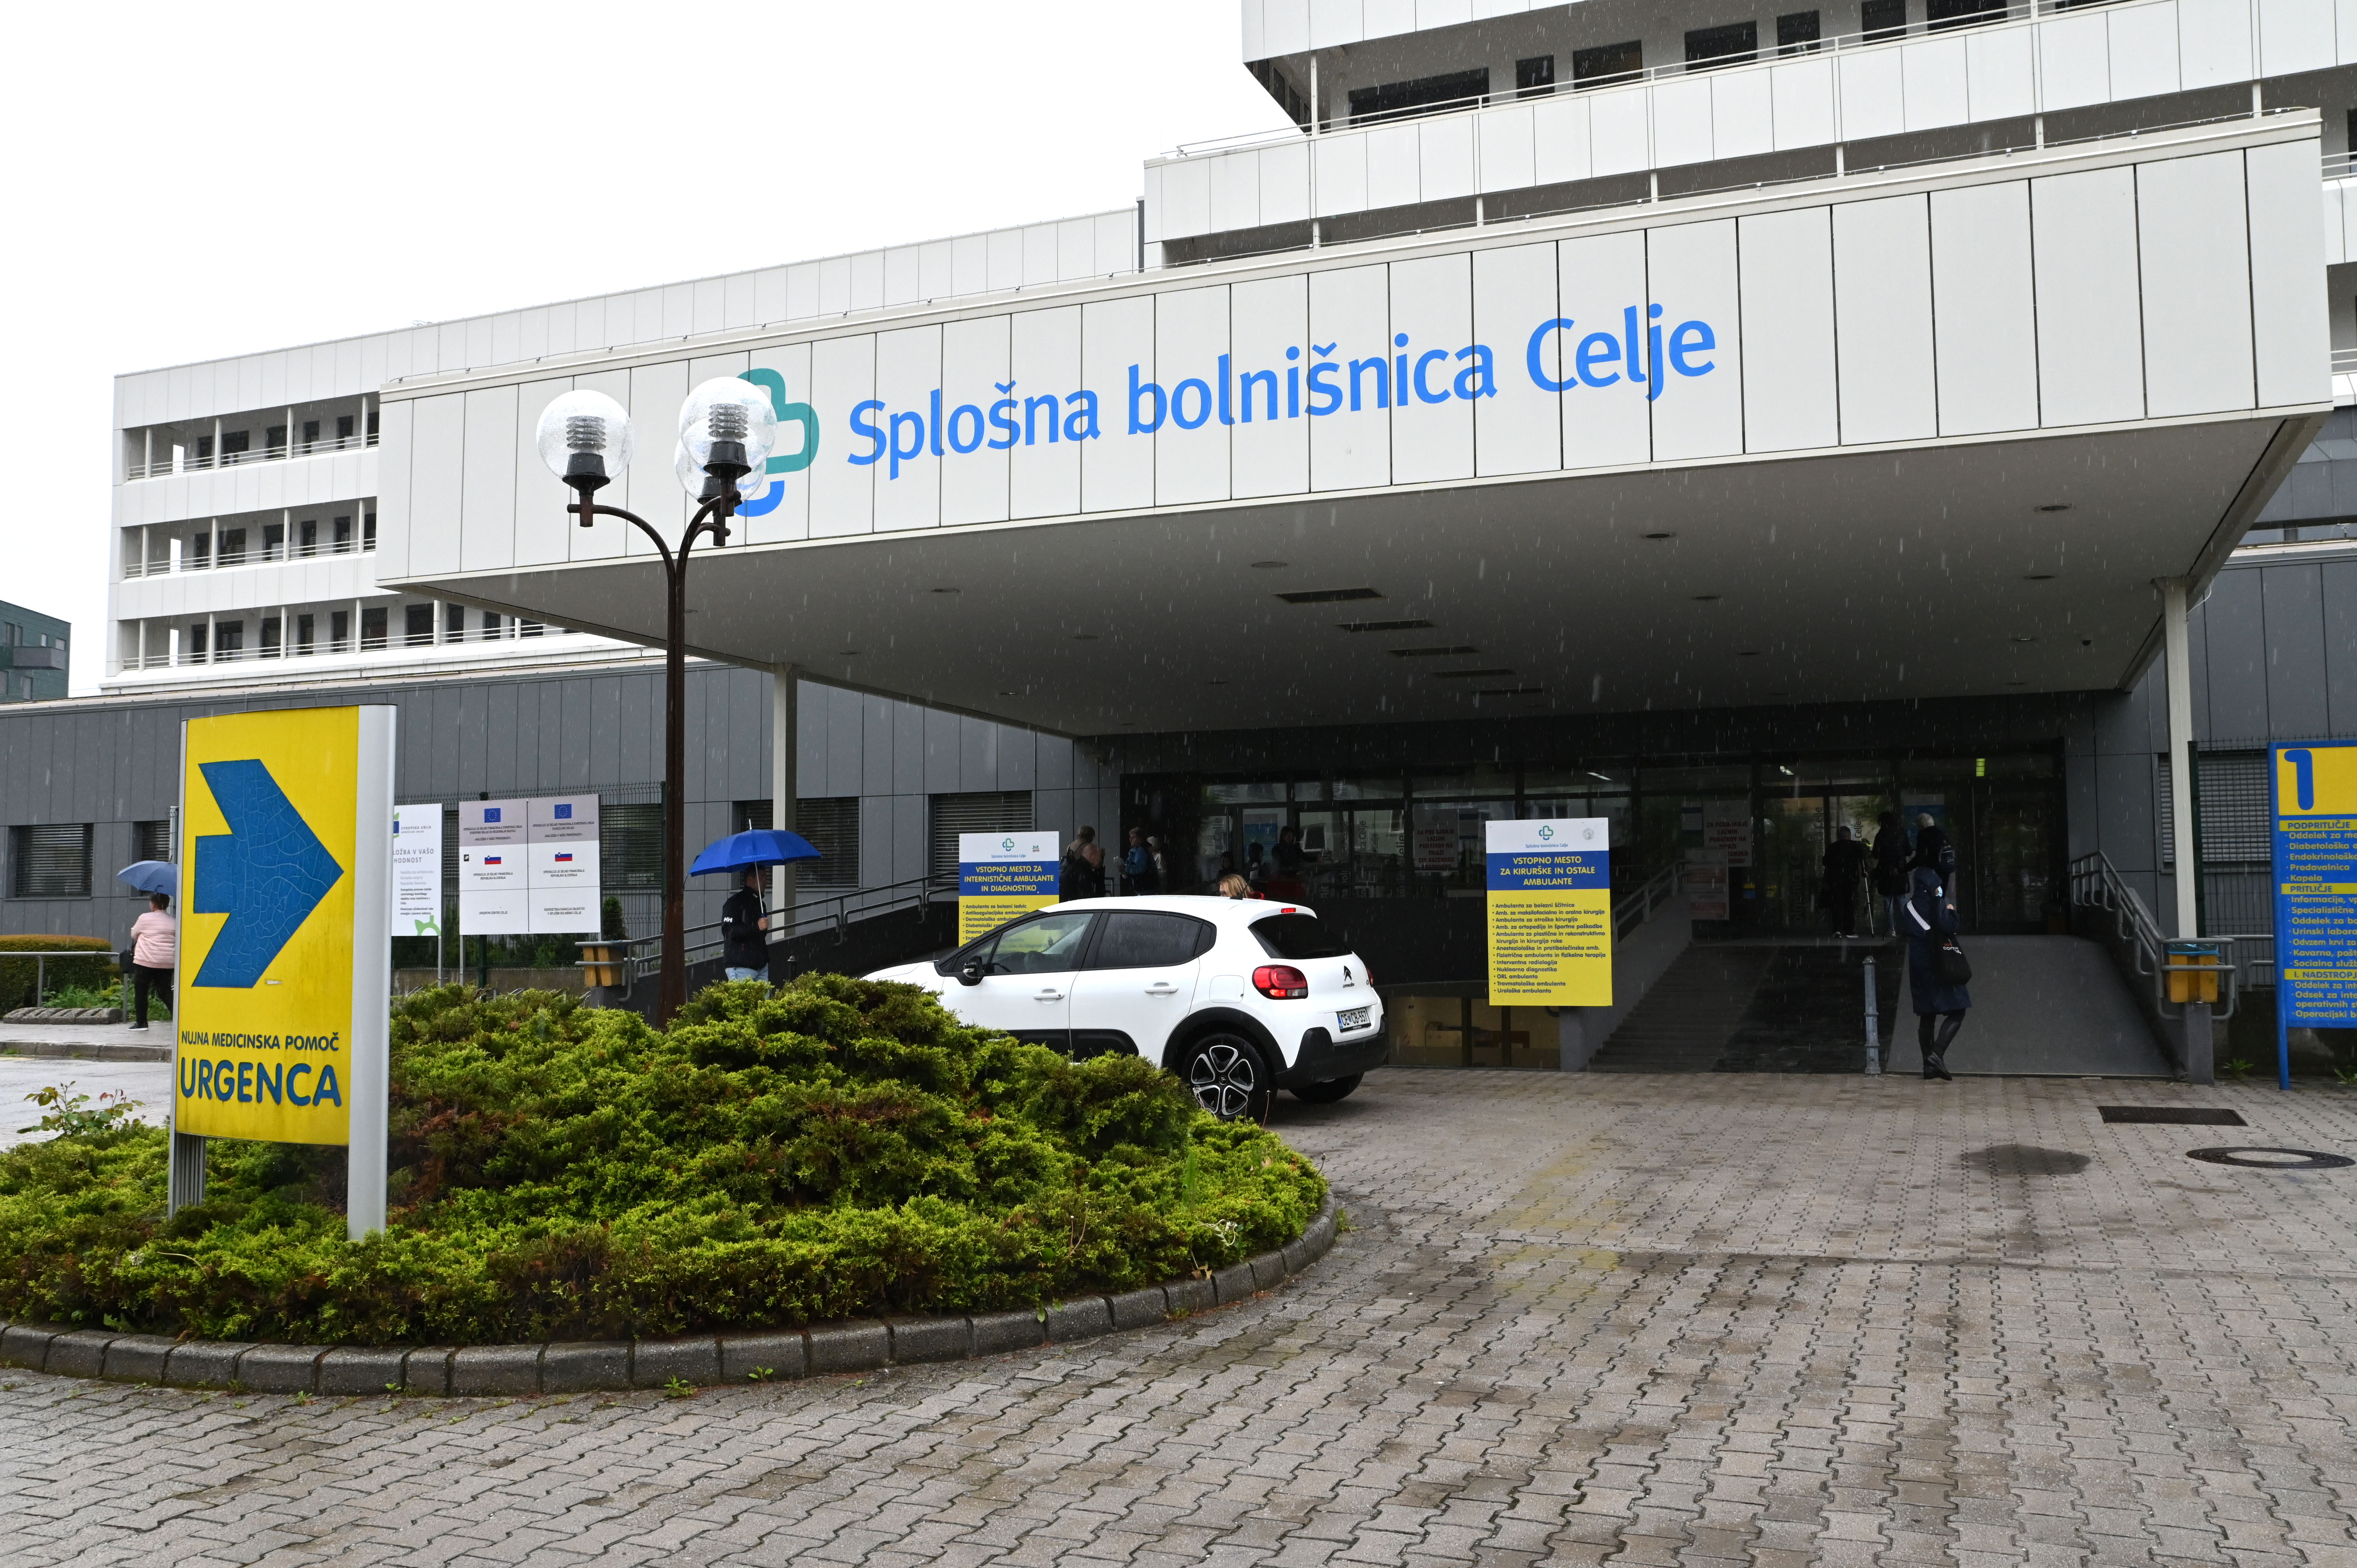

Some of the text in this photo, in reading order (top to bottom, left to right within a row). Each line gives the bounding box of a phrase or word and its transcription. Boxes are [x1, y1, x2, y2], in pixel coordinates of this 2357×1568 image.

[848, 299, 1715, 483] Splošna bolnišnica Celje
[2285, 749, 2314, 810] 1
[2287, 819, 2351, 830] PODPRITLIČJE
[1514, 866, 1551, 875] KIRURŠKE
[965, 874, 1012, 882] INTERNISTIČNE
[2291, 874, 2322, 883] Kapela
[2290, 883, 2333, 893] PRITLIČJE
[2292, 896, 2345, 904] Informacije,
[2292, 906, 2355, 915] Specialistične
[1341, 1011, 1367, 1026] CE CB-557
[2295, 1010, 2347, 1019] Operacijski
[182, 1031, 339, 1051] NUJNA MEDICINSKA POMOČ
[181, 1057, 342, 1107] URGENCA
